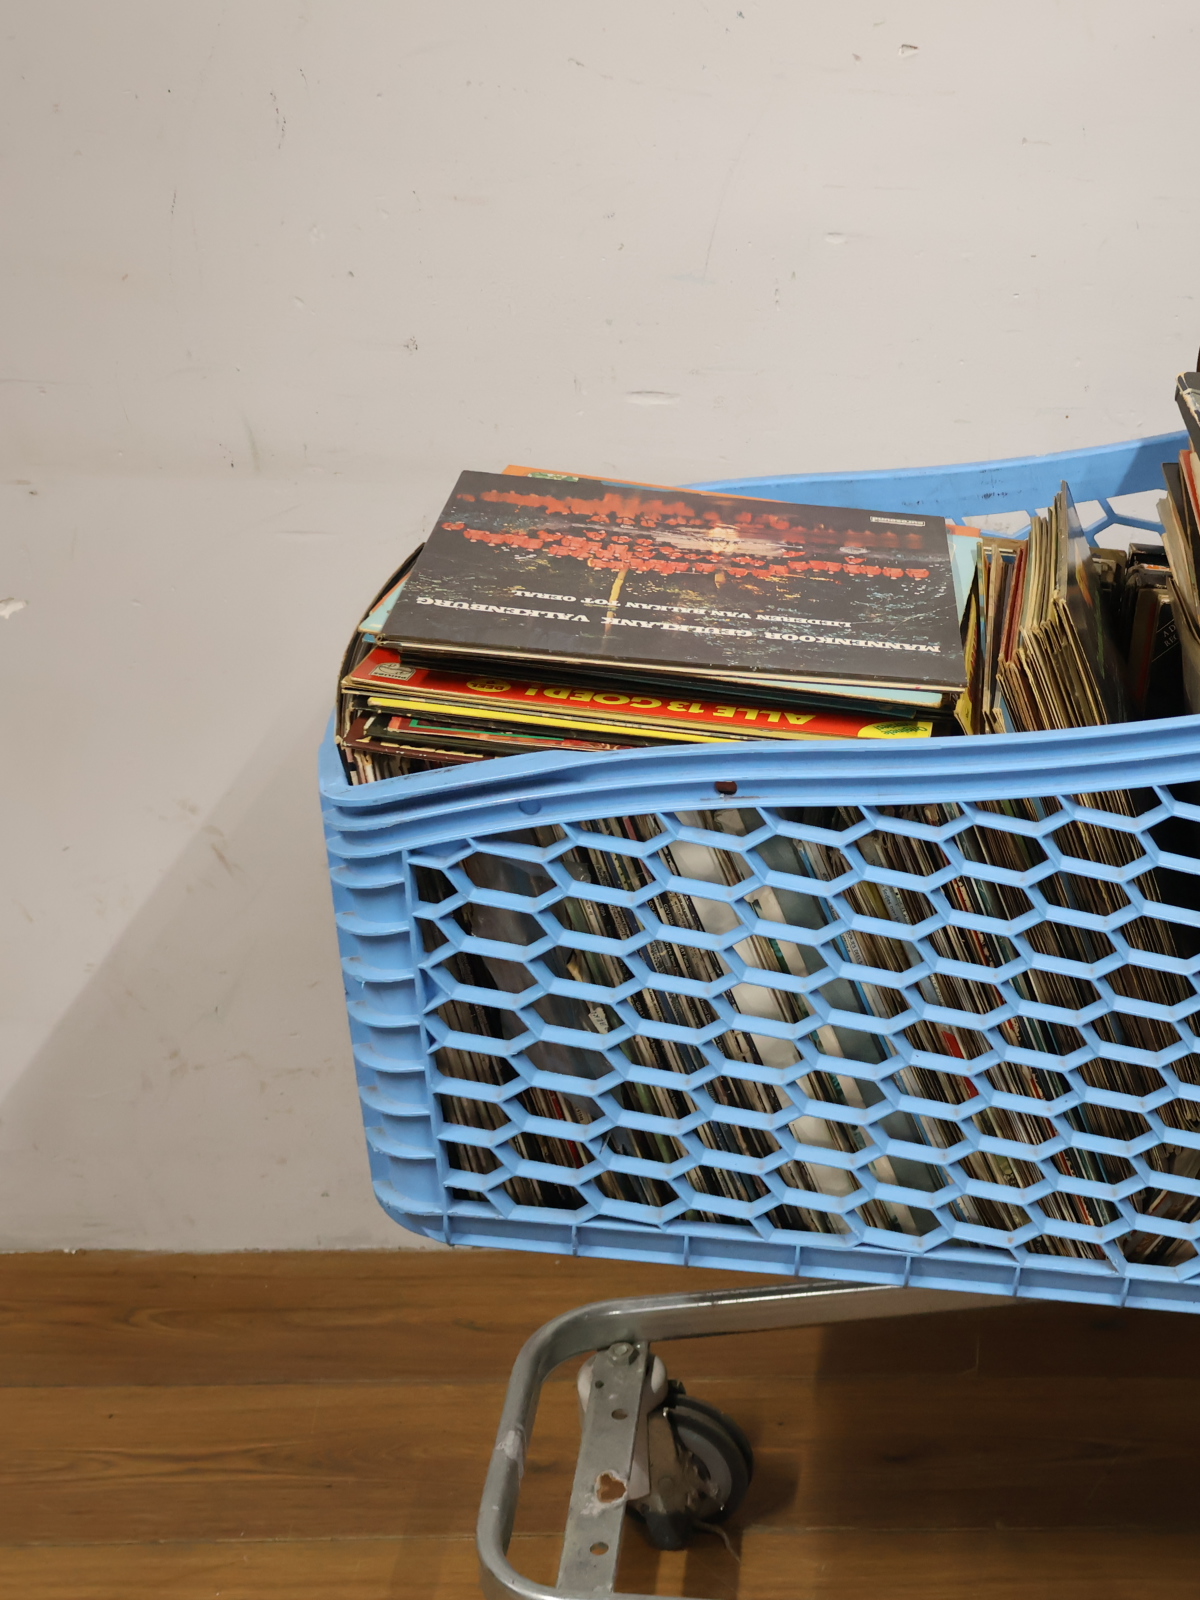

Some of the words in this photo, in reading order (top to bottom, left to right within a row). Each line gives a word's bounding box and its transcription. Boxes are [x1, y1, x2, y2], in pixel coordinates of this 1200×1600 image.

[512, 589, 577, 602] OERAL
[583, 597, 622, 607] TOT
[416, 596, 590, 623] VALKENBURG
[625, 602, 707, 617] BALKAN
[709, 609, 752, 620] VAN
[601, 616, 753, 638] GEULKLANK
[755, 613, 852, 628] LIEDEREN
[764, 631, 941, 653] MANNENKOOR
[373, 671, 407, 680] PHILIPS
[470, 682, 504, 691] DEEL
[524, 683, 663, 709] GOED!
[667, 700, 705, 714] 13
[712, 705, 817, 725] ALLE
